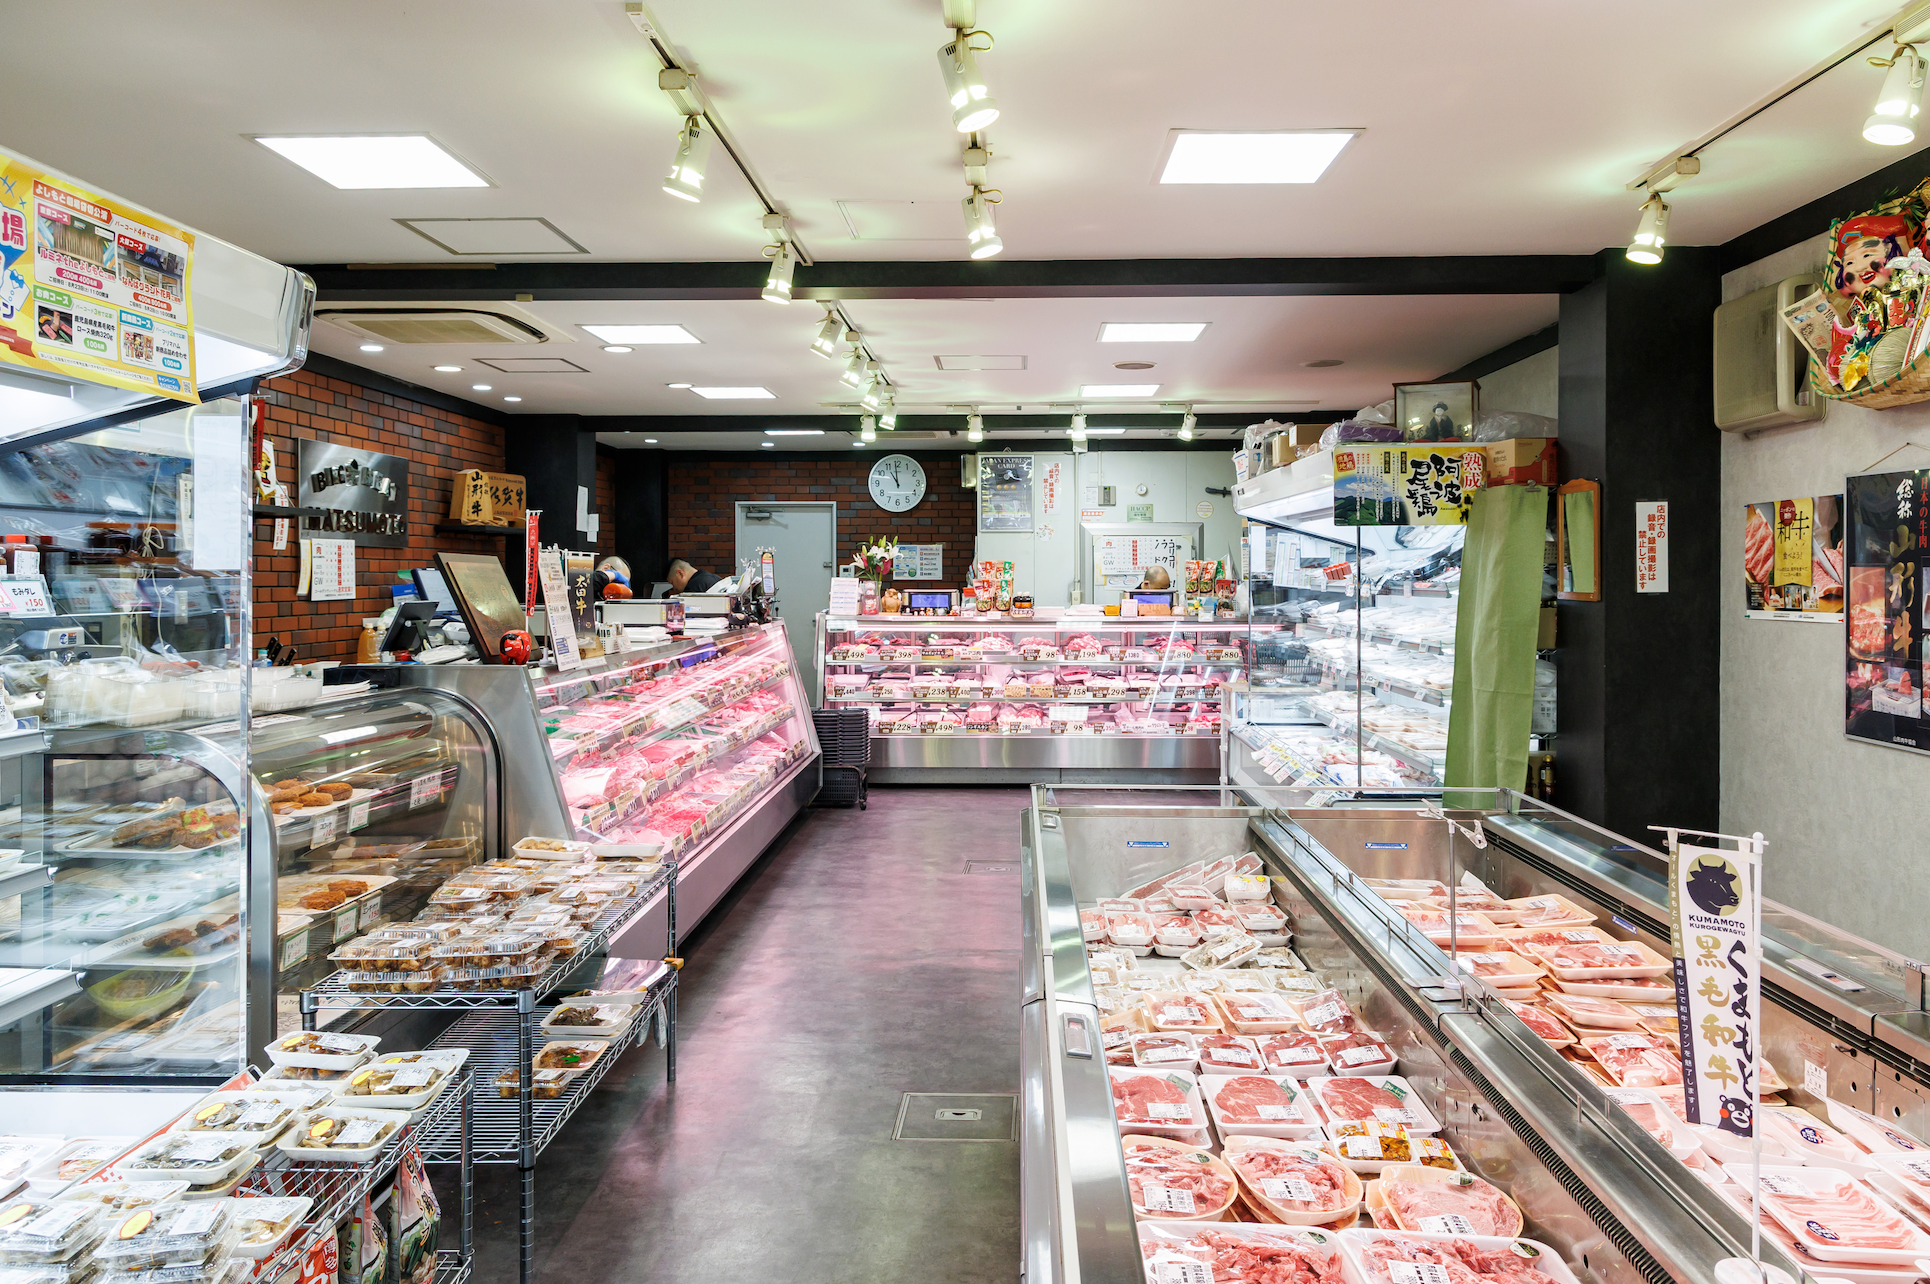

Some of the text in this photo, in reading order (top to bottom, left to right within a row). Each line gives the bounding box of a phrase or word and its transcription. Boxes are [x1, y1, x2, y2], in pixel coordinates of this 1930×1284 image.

[1464, 453, 1482, 489] 熟成
[472, 471, 482, 517] 山形牛
[1657, 505, 1666, 538] 店内での
[1919, 476, 1929, 549] 日本の牛肉
[1638, 531, 1647, 590] 禁止しています
[1648, 514, 1657, 581] 録音・録画撮影は
[574, 574, 588, 616] 太田牛
[1889, 525, 1917, 662] 山形牛
[850, 651, 865, 659] 498
[1082, 651, 1097, 659] 198
[1224, 651, 1239, 659] 880
[932, 688, 946, 696] 238
[1073, 688, 1086, 696] 158
[1111, 688, 1126, 696] 298
[1688, 914, 1746, 930] KUMAMOTO
[1689, 923, 1746, 937] KUROGEWAGYU
[1695, 934, 1740, 1091] 黒毛和牛
[1727, 940, 1753, 1101] くまもと
[323, 1240, 338, 1269] 博多
